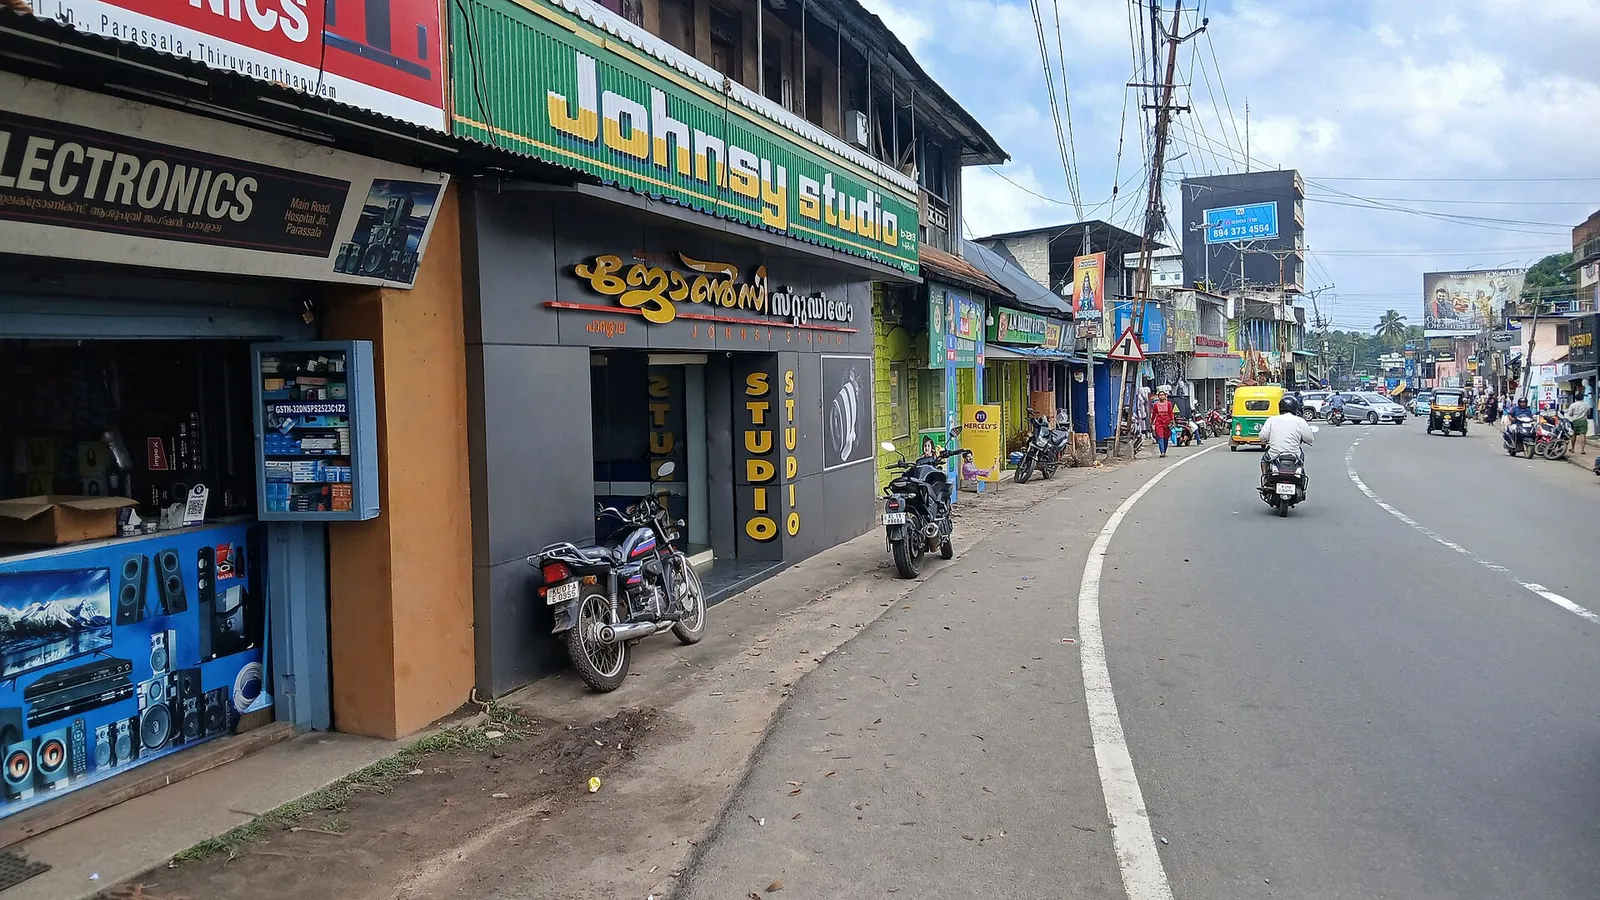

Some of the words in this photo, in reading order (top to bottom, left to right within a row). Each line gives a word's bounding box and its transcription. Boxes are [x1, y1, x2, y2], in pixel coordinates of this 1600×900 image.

[101, 14, 192, 58] Parassala,
[547, 51, 788, 234] Johnsy
[799, 172, 898, 247] studio
[290, 197, 310, 209] Main
[310, 201, 331, 214] Road,
[285, 210, 316, 225] Hospital
[285, 223, 322, 237] Parassala
[1230, 226, 1246, 235] 373
[1248, 223, 1269, 233] 4554
[691, 324, 772, 342] JOHNSY
[785, 331, 842, 344] STUDIO
[745, 372, 776, 541] STUDIO
[784, 370, 800, 536] STUDIO
